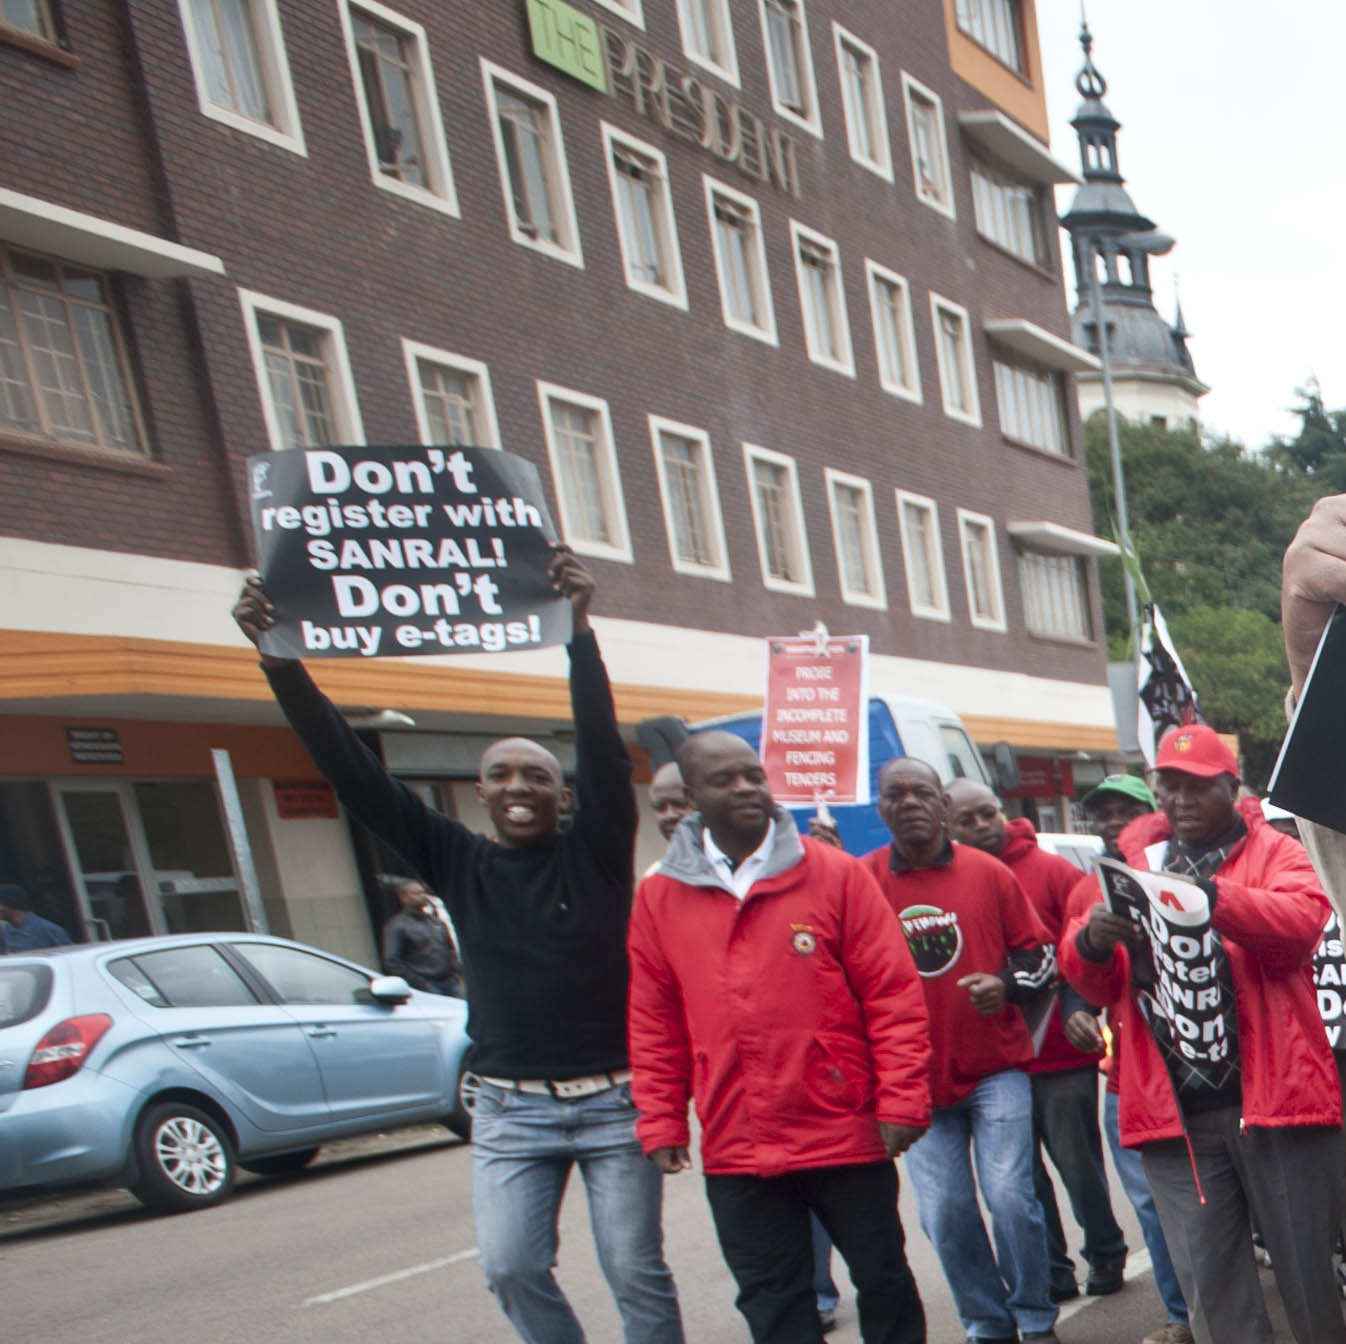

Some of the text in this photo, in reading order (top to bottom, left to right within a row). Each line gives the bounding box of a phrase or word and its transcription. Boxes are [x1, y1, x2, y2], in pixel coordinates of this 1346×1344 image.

[601, 25, 800, 199] PRESIDENT
[305, 449, 479, 495] Don't
[261, 497, 543, 537] register with
[307, 537, 508, 570] SANRAL!
[331, 572, 504, 618] Don't
[301, 614, 542, 657] buy e-tags!
[796, 666, 832, 680] PROBE
[786, 687, 840, 701] INTO THE
[776, 709, 848, 723] INCOMPLETE
[773, 730, 849, 744] MUSEUM AND
[785, 751, 836, 765] FENCING
[784, 772, 836, 787] TENDERS
